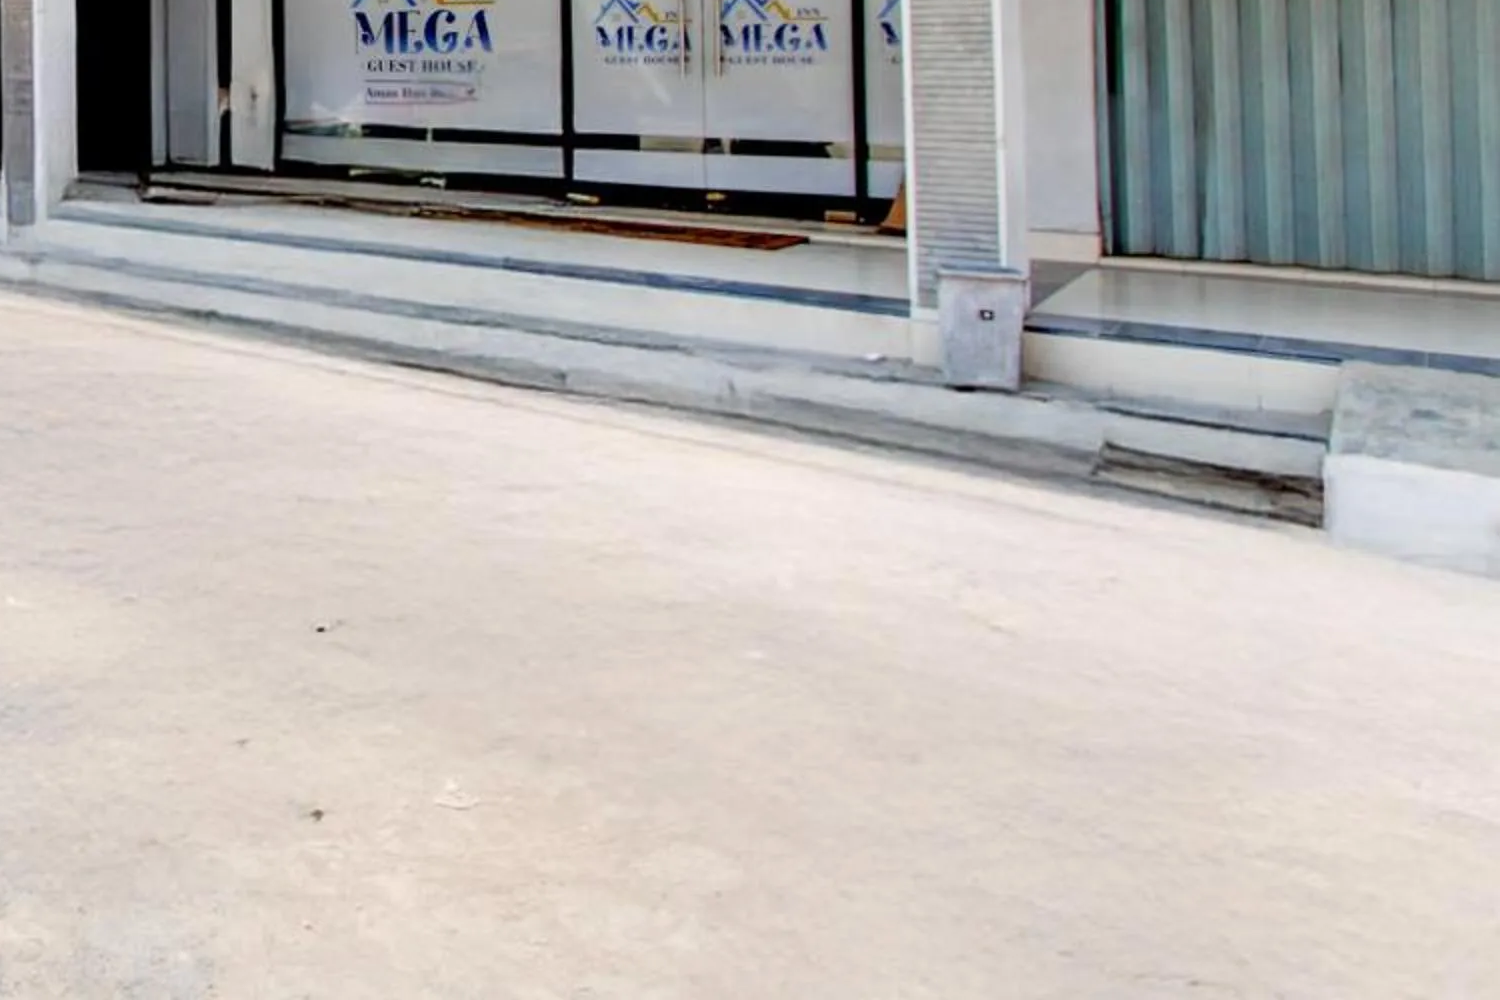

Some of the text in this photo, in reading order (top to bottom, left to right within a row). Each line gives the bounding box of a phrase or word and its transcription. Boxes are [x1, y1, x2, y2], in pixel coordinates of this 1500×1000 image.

[355, 8, 493, 55] MEGA
[596, 25, 691, 53] MEGA
[720, 23, 828, 53] MEGA
[367, 59, 477, 73] GUEST HOUSE
